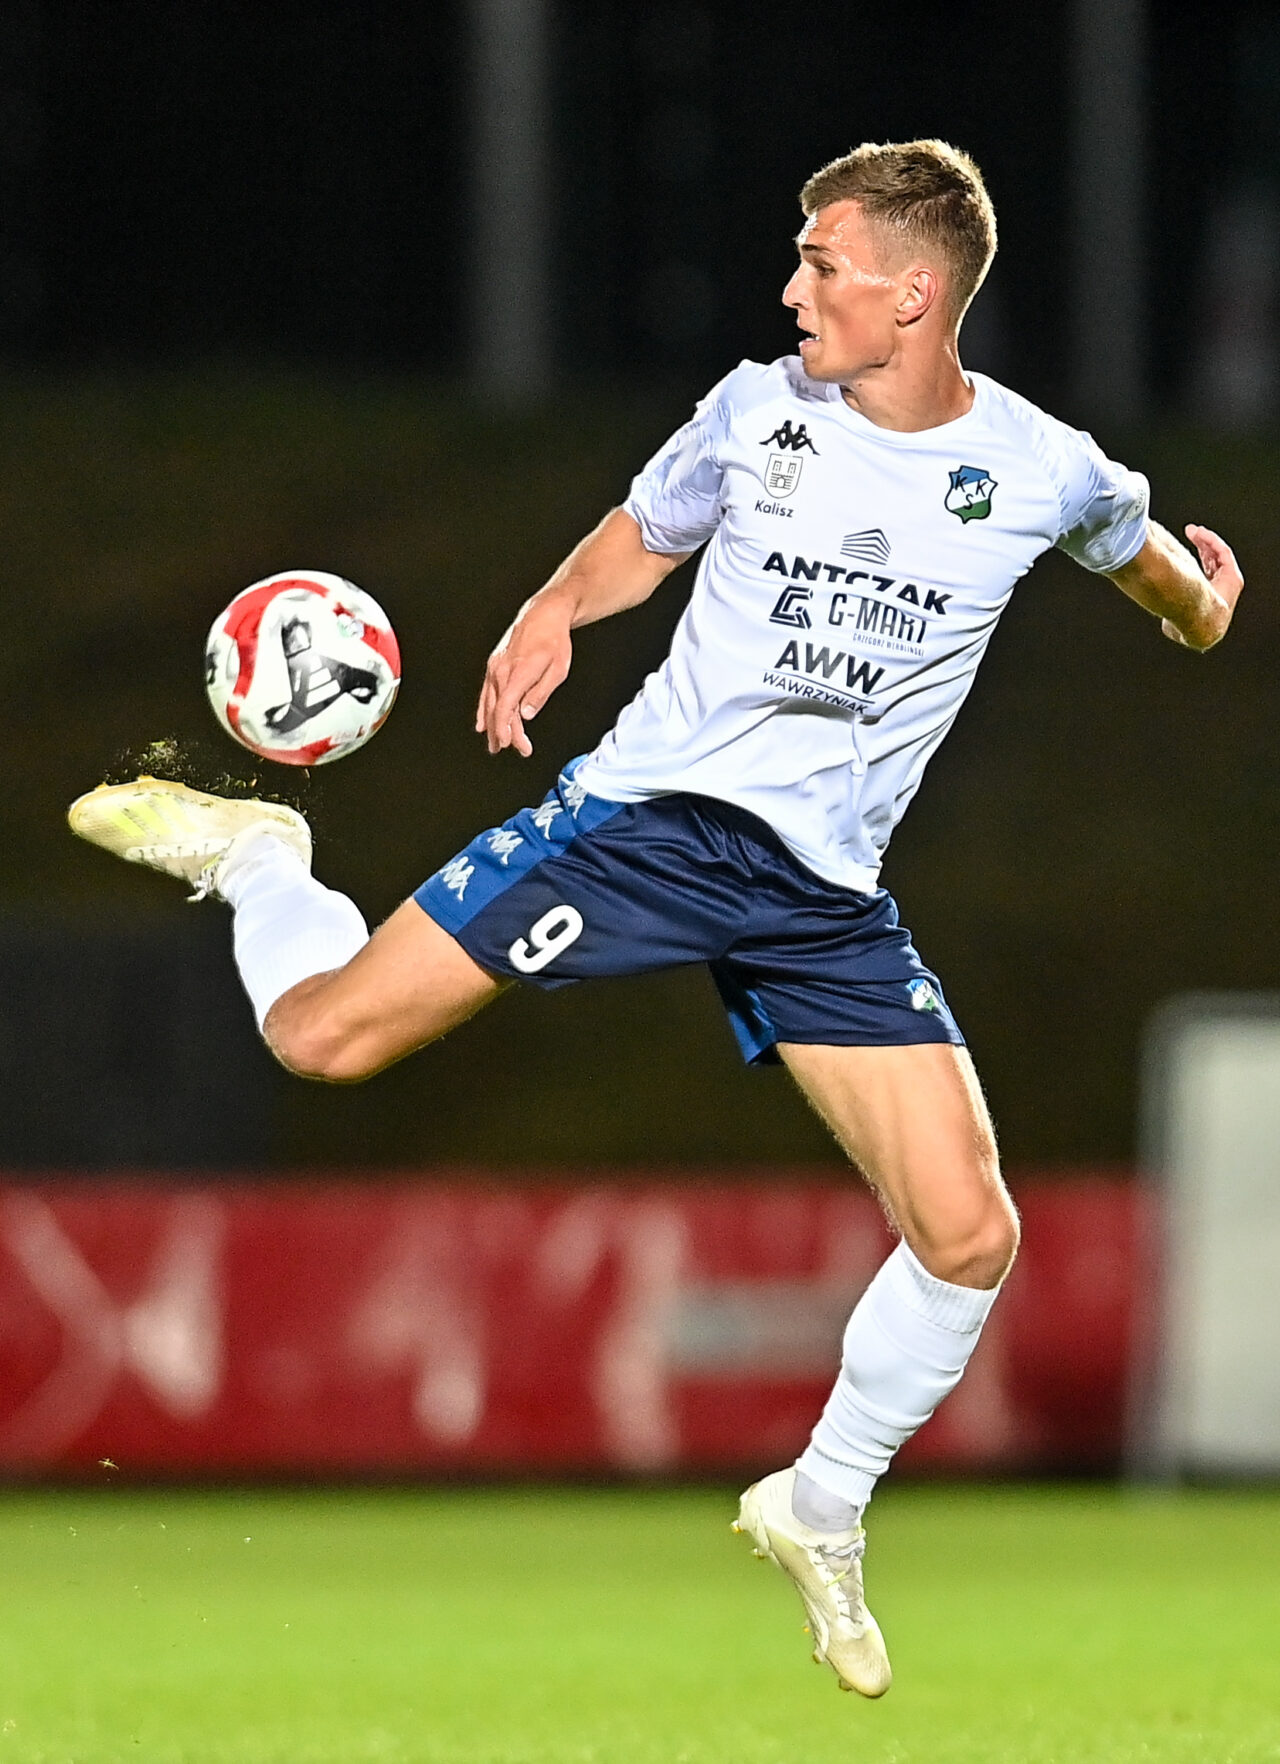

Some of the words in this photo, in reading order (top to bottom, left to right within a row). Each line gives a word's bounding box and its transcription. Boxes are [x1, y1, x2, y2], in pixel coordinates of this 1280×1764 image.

[754, 499, 794, 518] Kalisz
[774, 639, 886, 695] AWW
[762, 672, 868, 714] WAWRZYNIAK
[507, 904, 584, 973] 9
